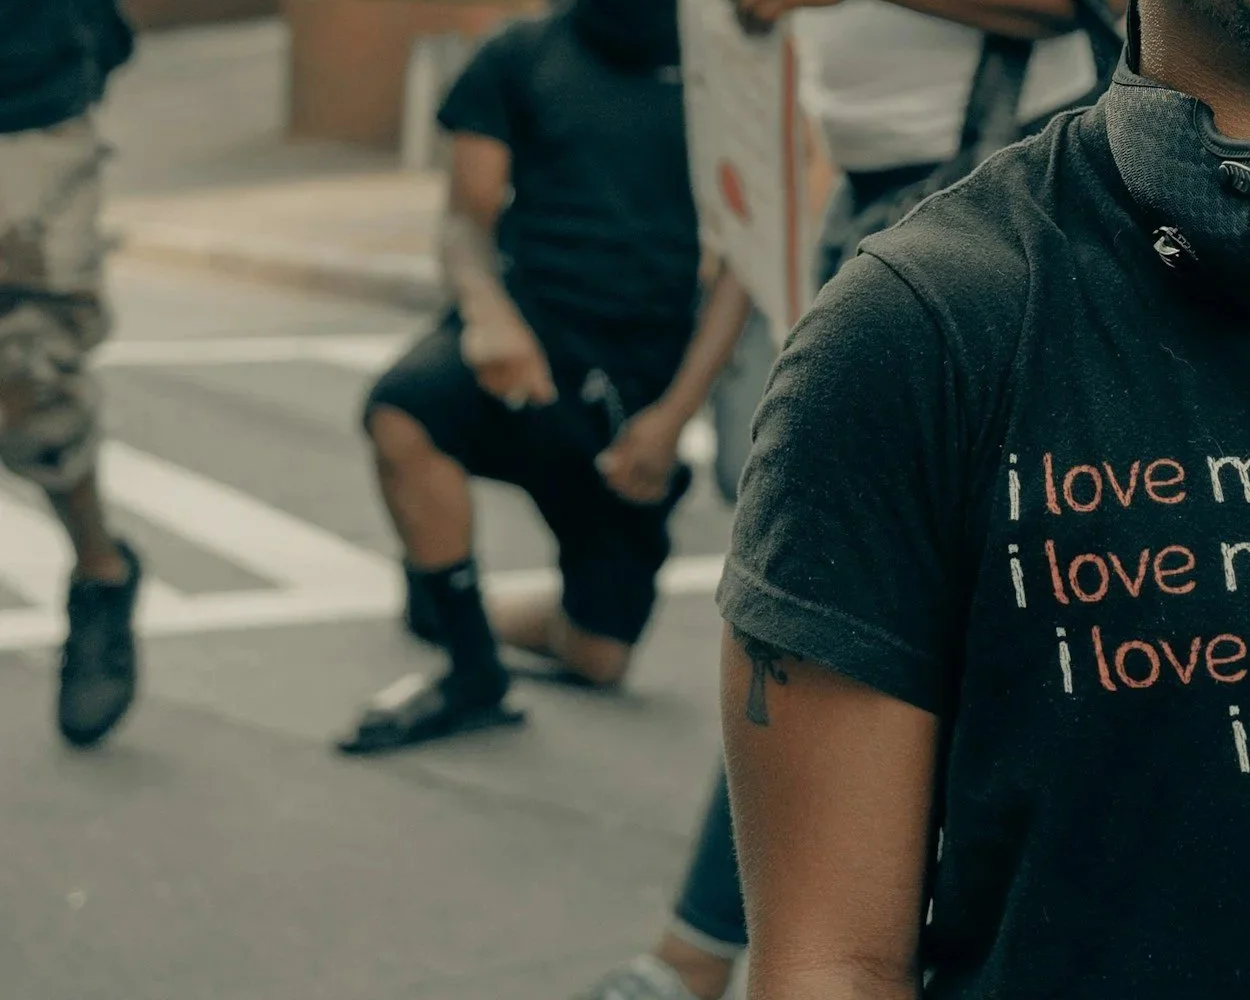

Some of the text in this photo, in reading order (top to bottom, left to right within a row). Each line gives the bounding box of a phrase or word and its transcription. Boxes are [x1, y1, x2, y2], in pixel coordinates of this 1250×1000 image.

[1008, 452, 1021, 521] i
[1042, 452, 1187, 515] love
[1007, 543, 1027, 608] i
[1044, 539, 1196, 605] love
[1055, 626, 1073, 694] i
[1091, 625, 1247, 692] love
[1228, 705, 1250, 774] i
